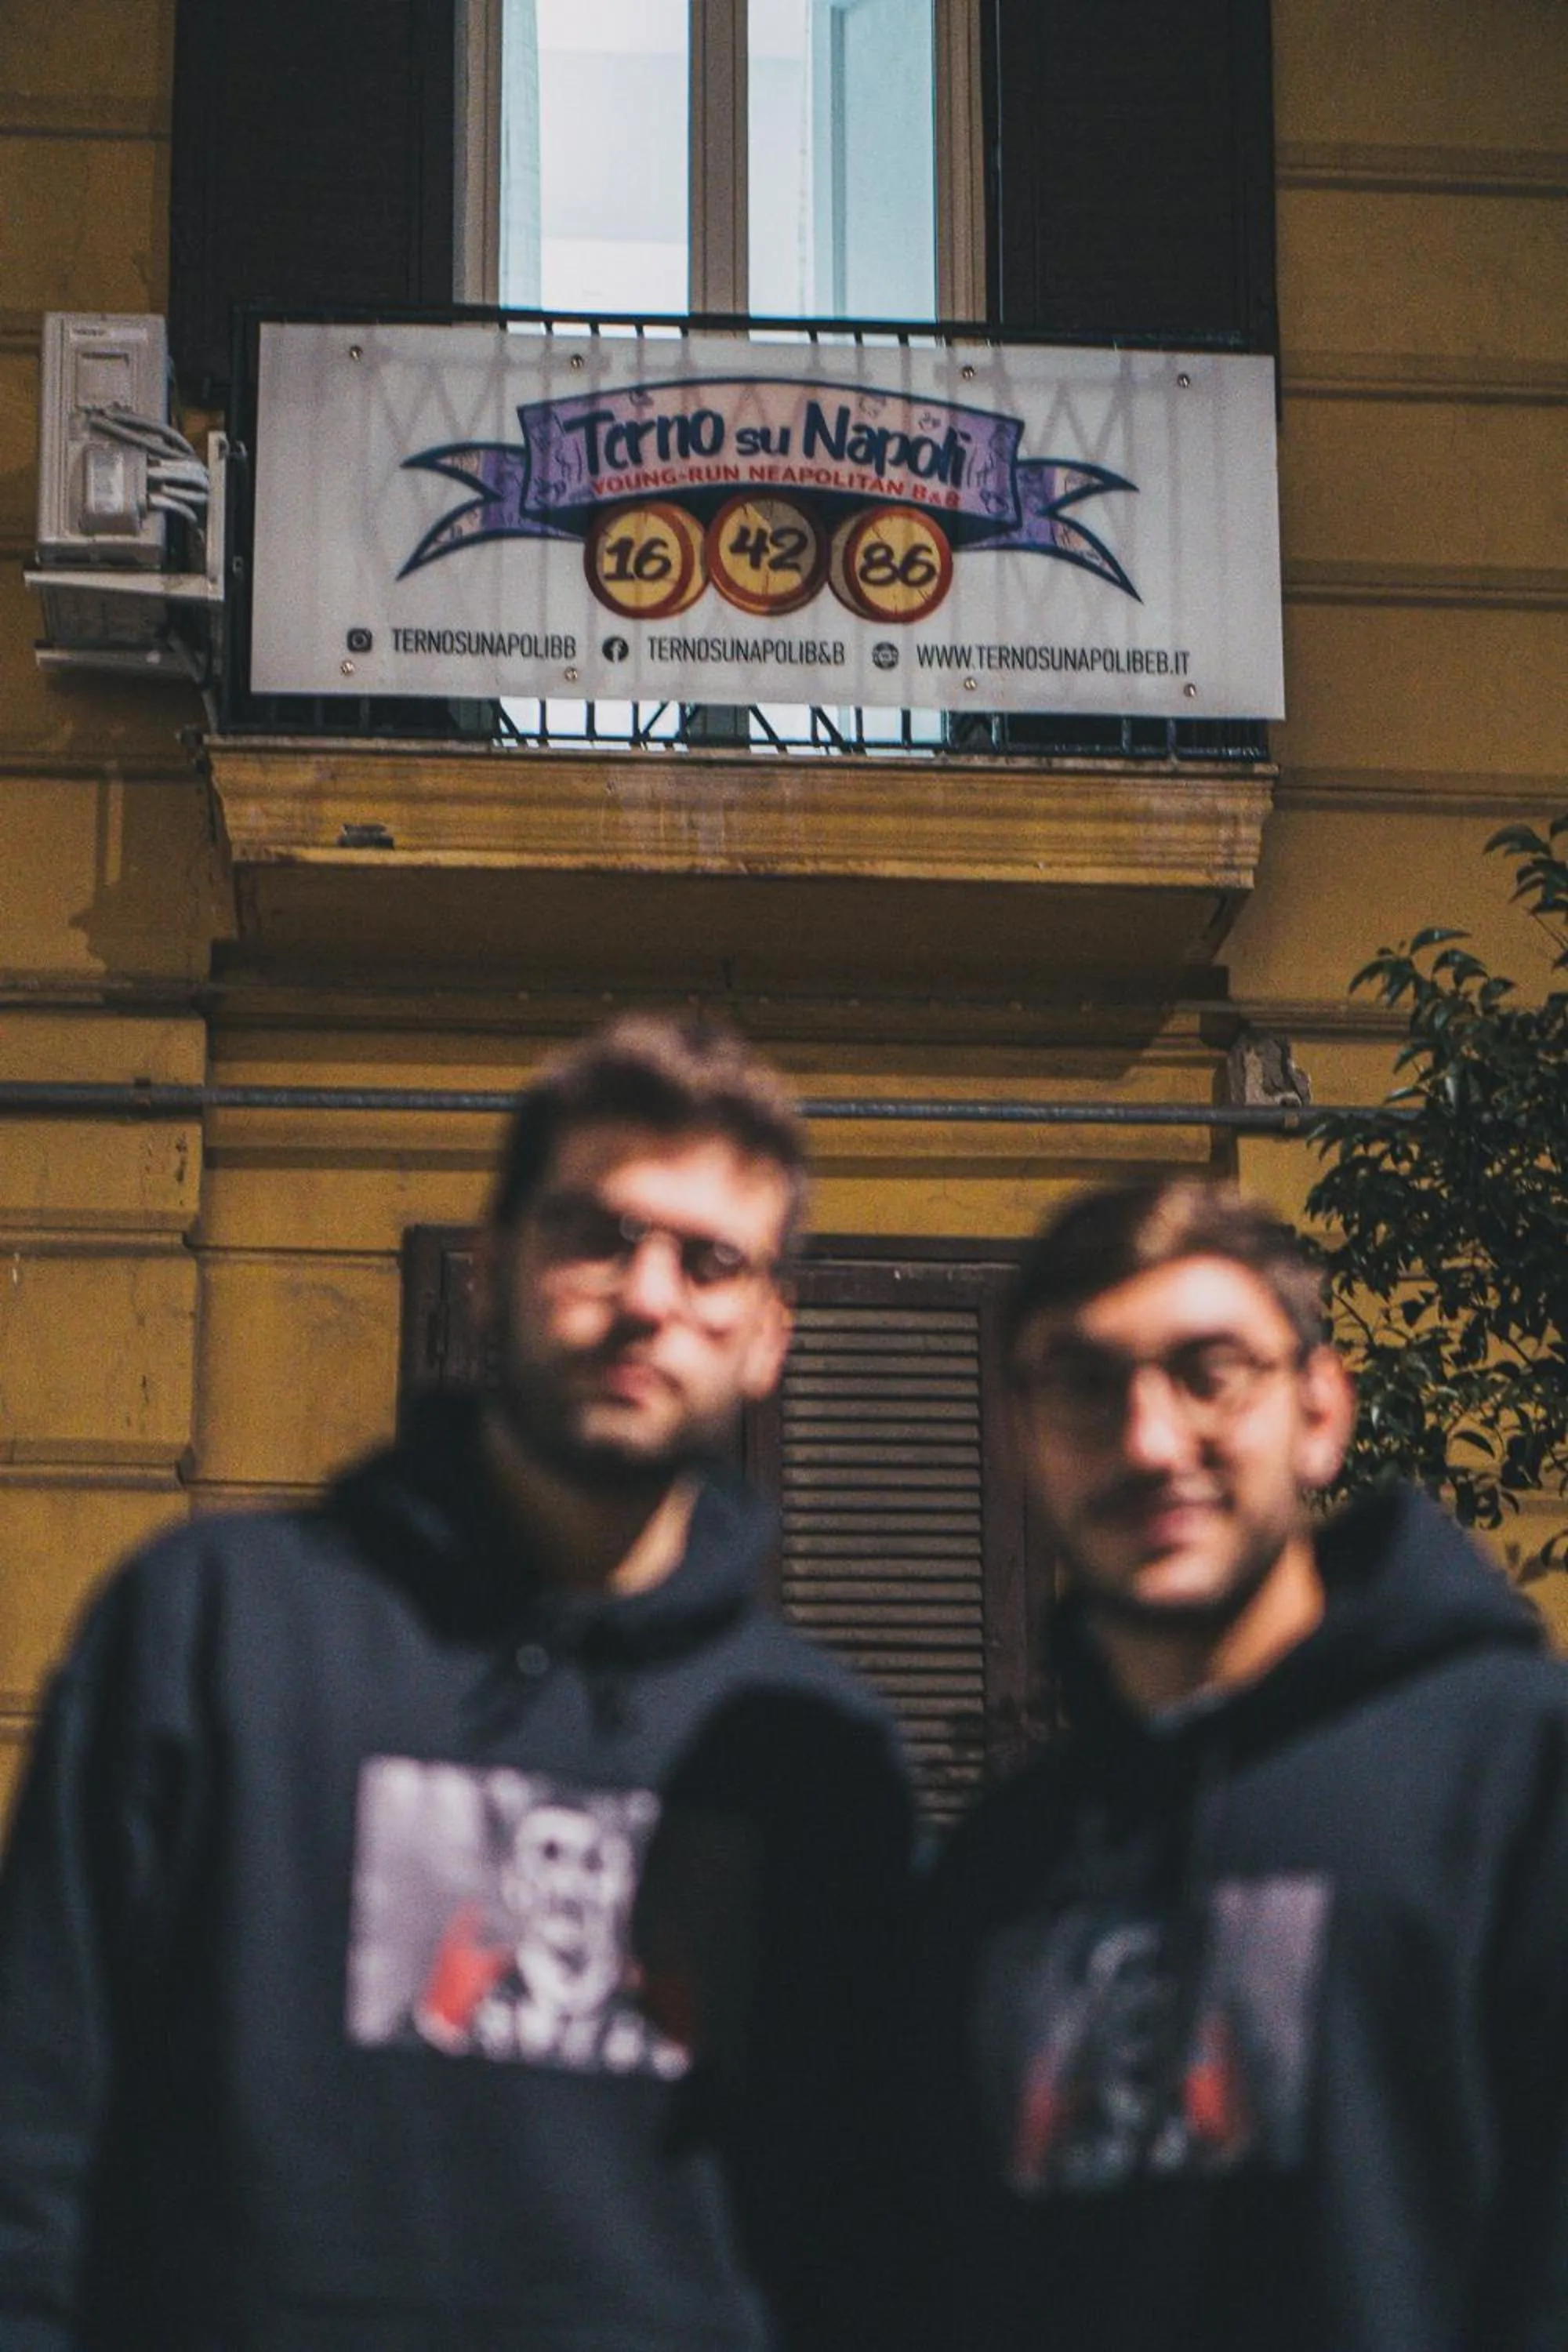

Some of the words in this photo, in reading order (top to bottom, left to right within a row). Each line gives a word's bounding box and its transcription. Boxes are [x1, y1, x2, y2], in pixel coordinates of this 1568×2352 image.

[562, 408, 725, 477] Terno
[735, 426, 791, 456] su
[801, 399, 972, 489] Napoli
[590, 464, 739, 496] YOUNG-RUN
[749, 465, 904, 496] NEAPOLITAN
[912, 483, 960, 508] B&B
[602, 536, 673, 582] 16
[729, 526, 808, 572] 42
[858, 542, 937, 588] 86
[392, 627, 577, 659] TERNOSUNAPOLIBB
[647, 636, 846, 666] TERNOSUNAPOLIB&B
[916, 643, 1191, 677] WWW.TERNOSUNAPOLIBEB.IT
